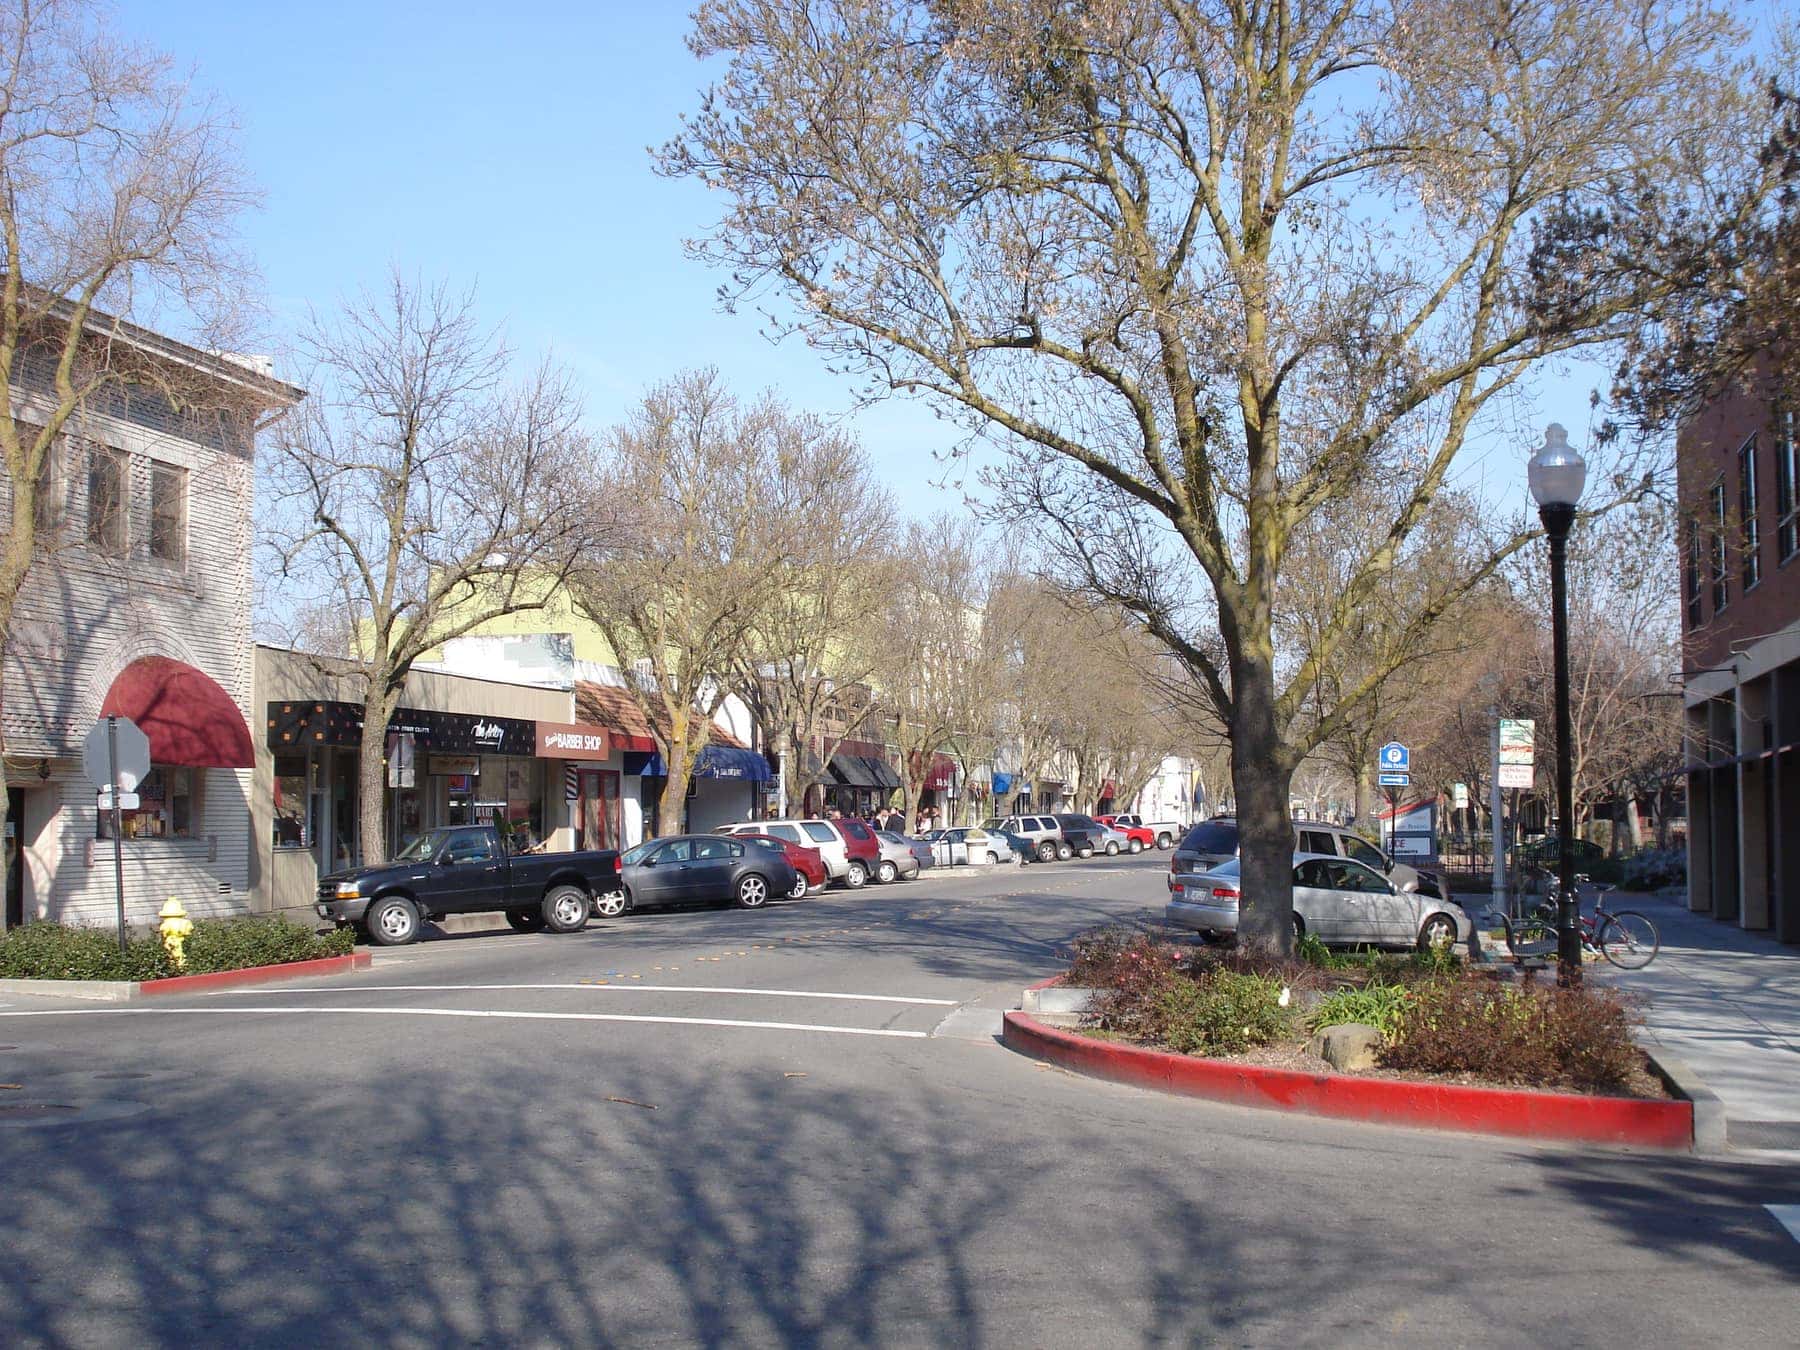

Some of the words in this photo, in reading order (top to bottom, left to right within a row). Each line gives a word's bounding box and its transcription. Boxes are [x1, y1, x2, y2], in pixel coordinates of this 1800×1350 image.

[557, 733, 584, 750] BARBER
[584, 735, 602, 751] SHOP
[1391, 750, 1399, 760] P
